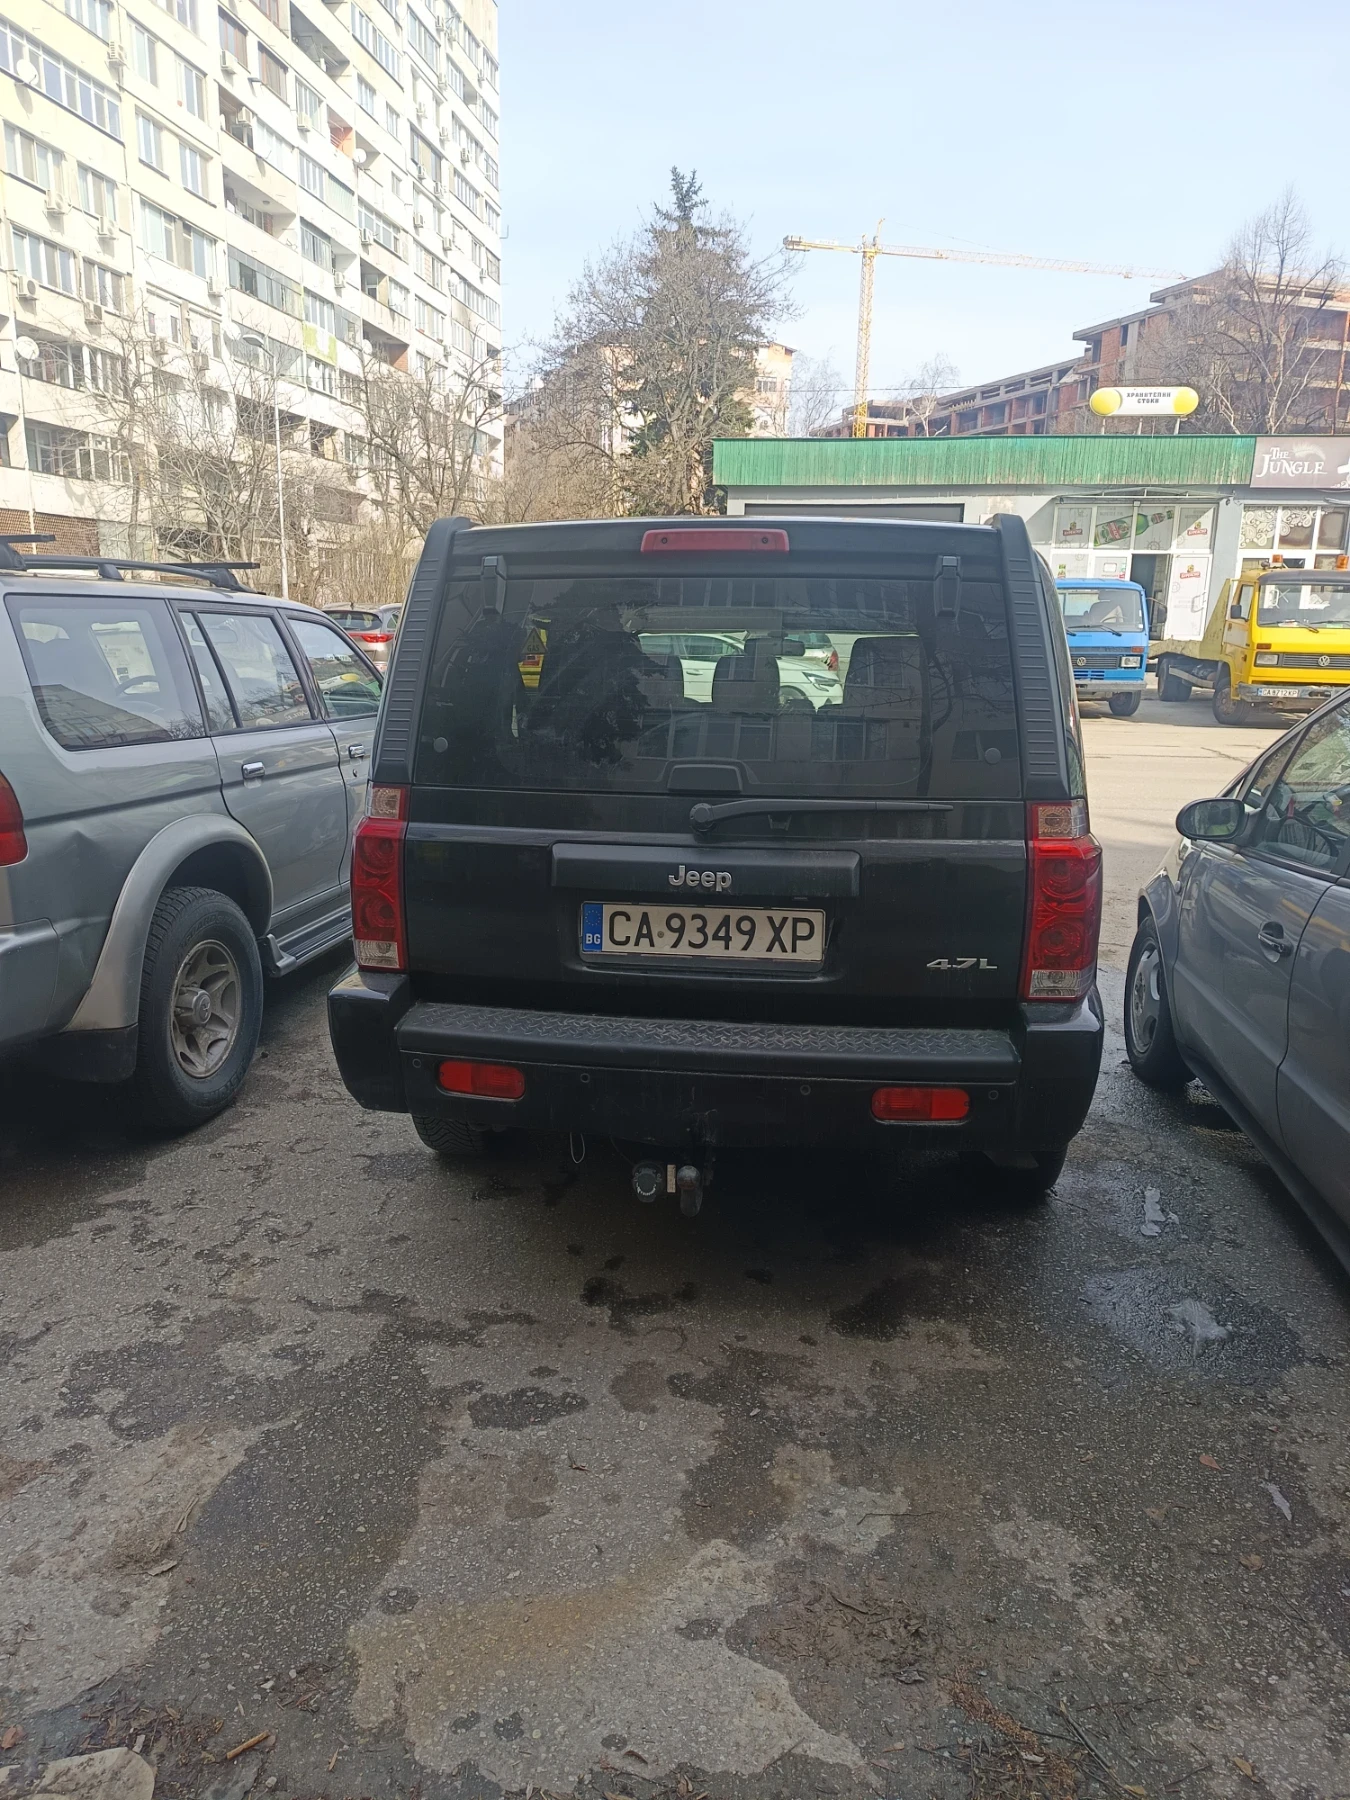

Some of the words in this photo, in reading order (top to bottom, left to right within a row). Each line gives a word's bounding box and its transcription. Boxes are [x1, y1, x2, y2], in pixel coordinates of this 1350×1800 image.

[668, 865, 732, 892] Jeep
[585, 933, 601, 945] BG
[608, 910, 655, 948] CA
[665, 912, 756, 951] 9349
[765, 915, 815, 954] XP
[926, 957, 998, 970] 4.7L
